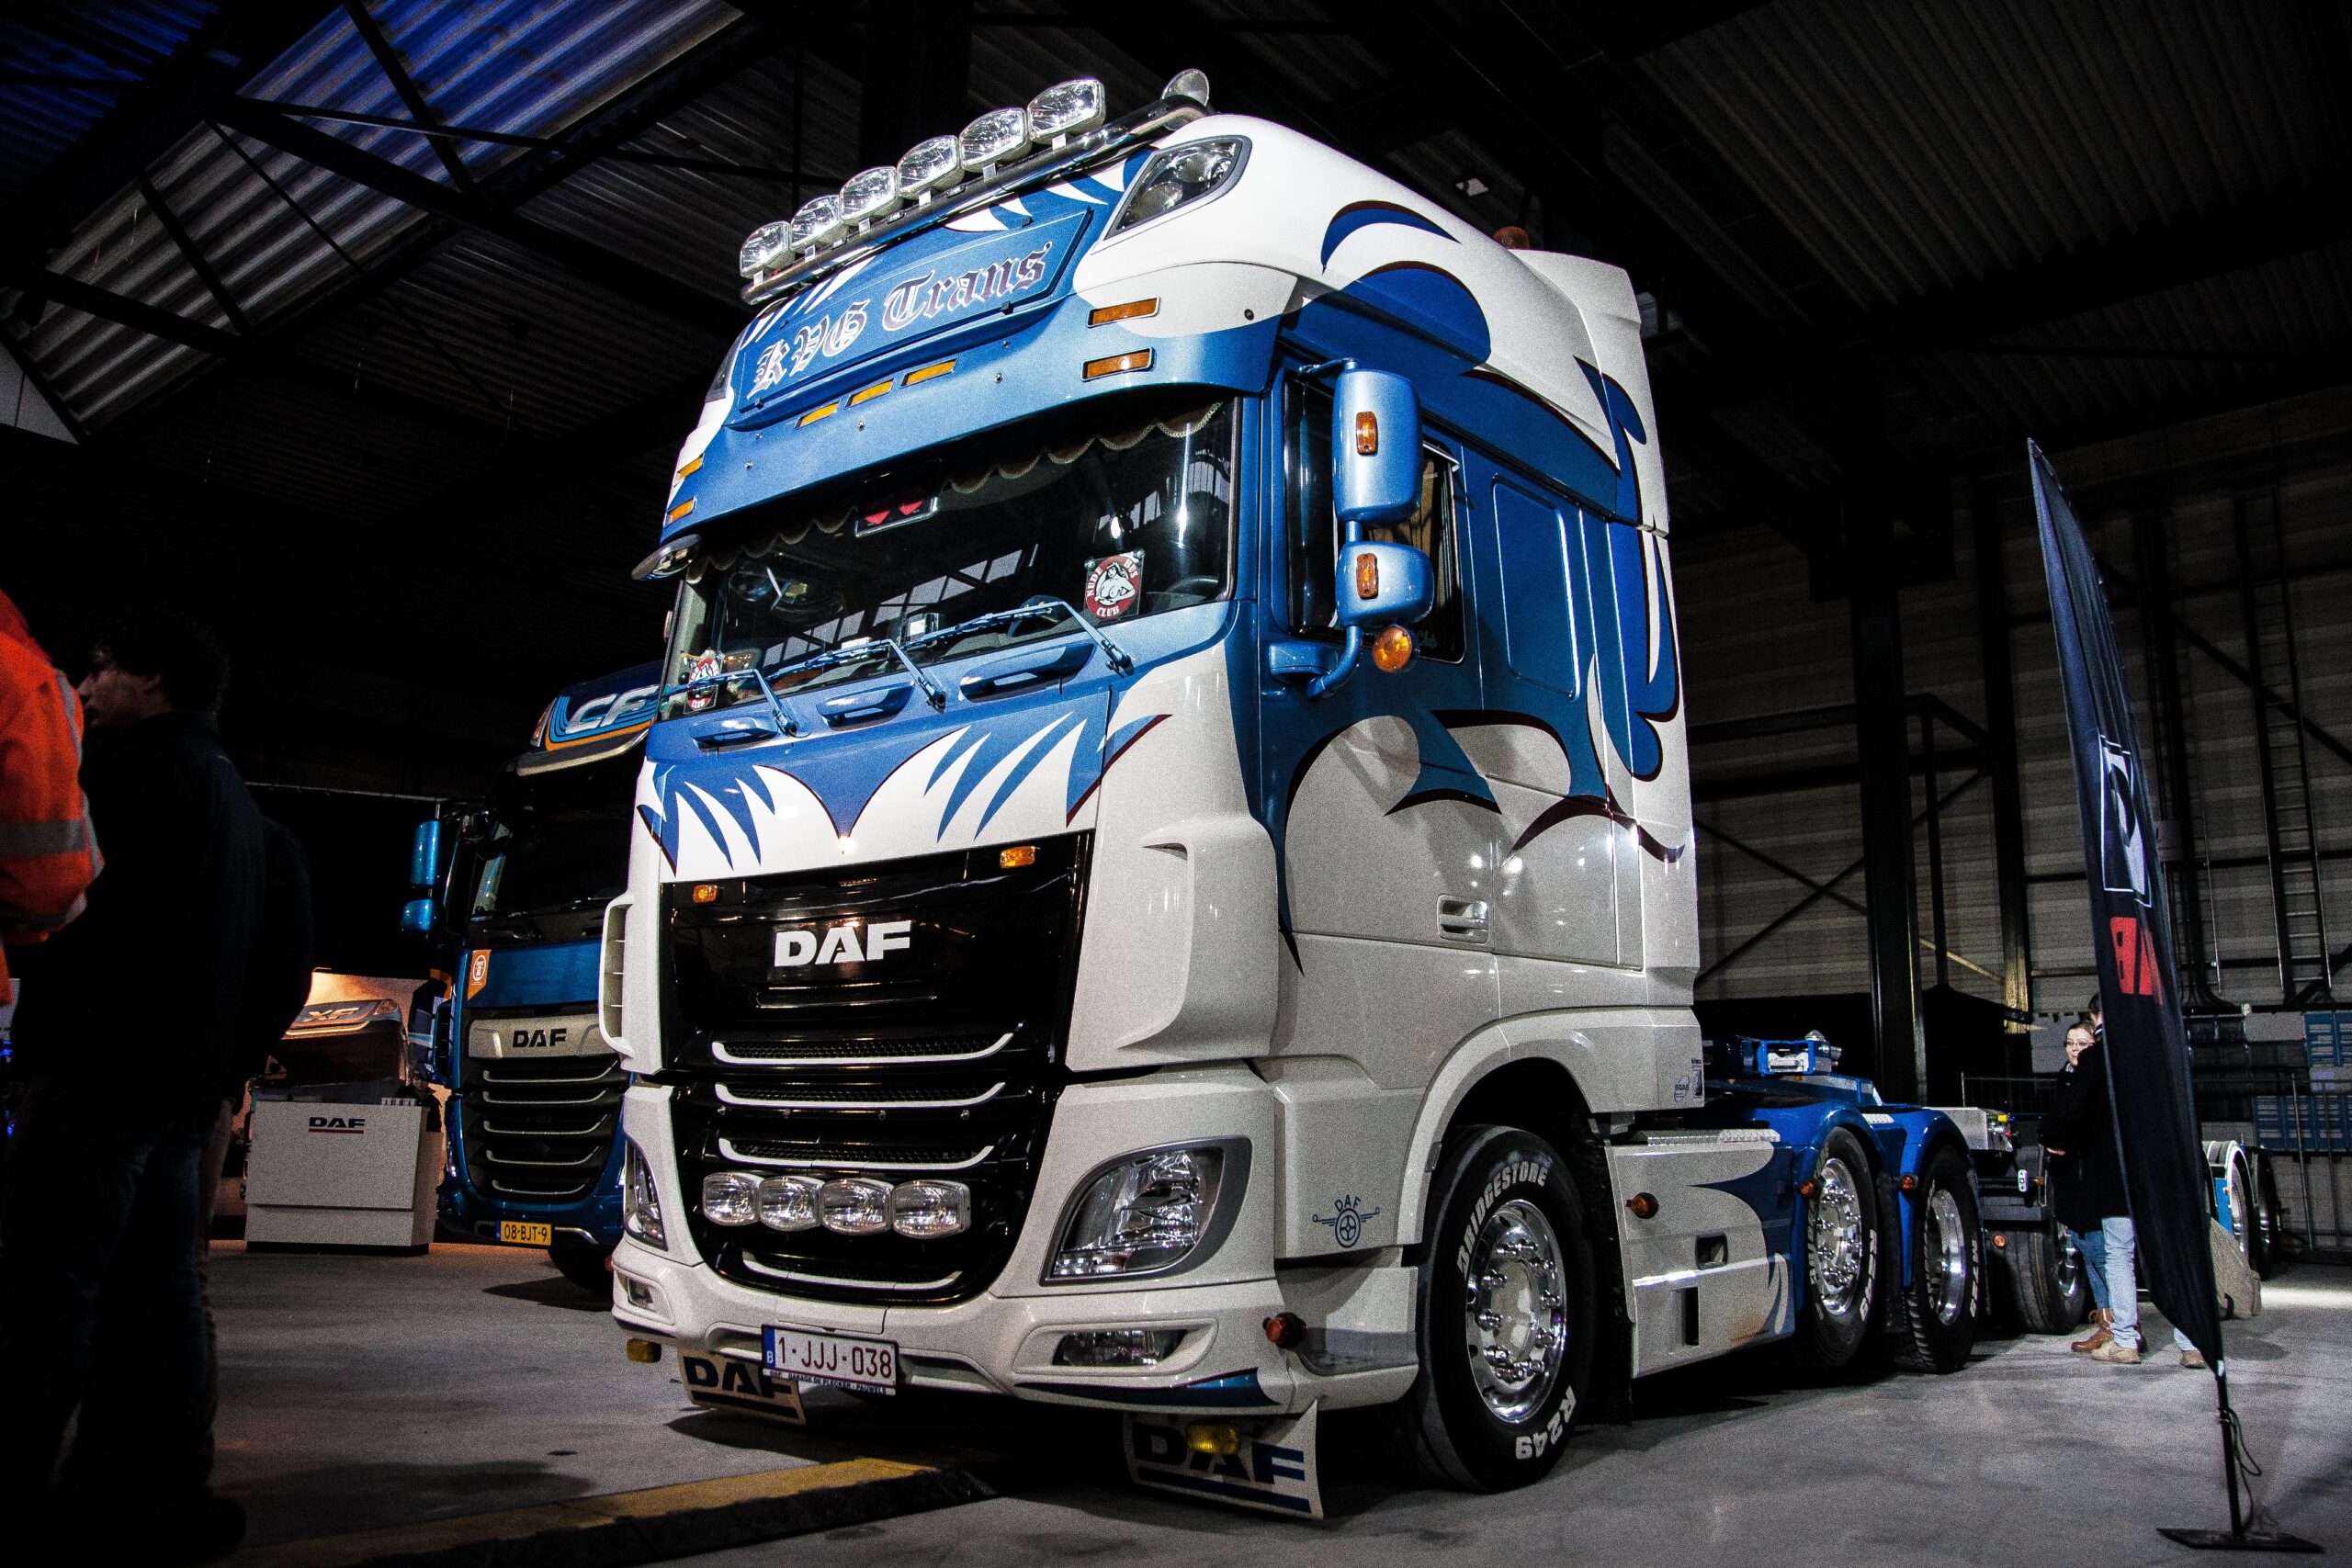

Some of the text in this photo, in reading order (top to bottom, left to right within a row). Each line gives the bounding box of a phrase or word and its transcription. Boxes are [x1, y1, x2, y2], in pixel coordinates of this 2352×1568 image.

[882, 241, 1053, 332] Trans
[1123, 558, 1138, 579] BUS
[1087, 566, 1103, 598] NUDE
[1096, 605, 1120, 617] CLUB
[565, 684, 660, 735] CF
[775, 920, 911, 967] DAF
[302, 1007, 359, 1022] XF
[513, 1028, 568, 1048] DAF
[309, 1117, 366, 1129] DAF
[1334, 1194, 1361, 1213] DAF
[1456, 1161, 1549, 1281] BRIDGESTONE
[504, 1224, 548, 1243] 08-BJT-9
[766, 1350, 775, 1364] B
[778, 1337, 892, 1379] 1-JJJ-038
[1515, 1384, 1577, 1461] R249
